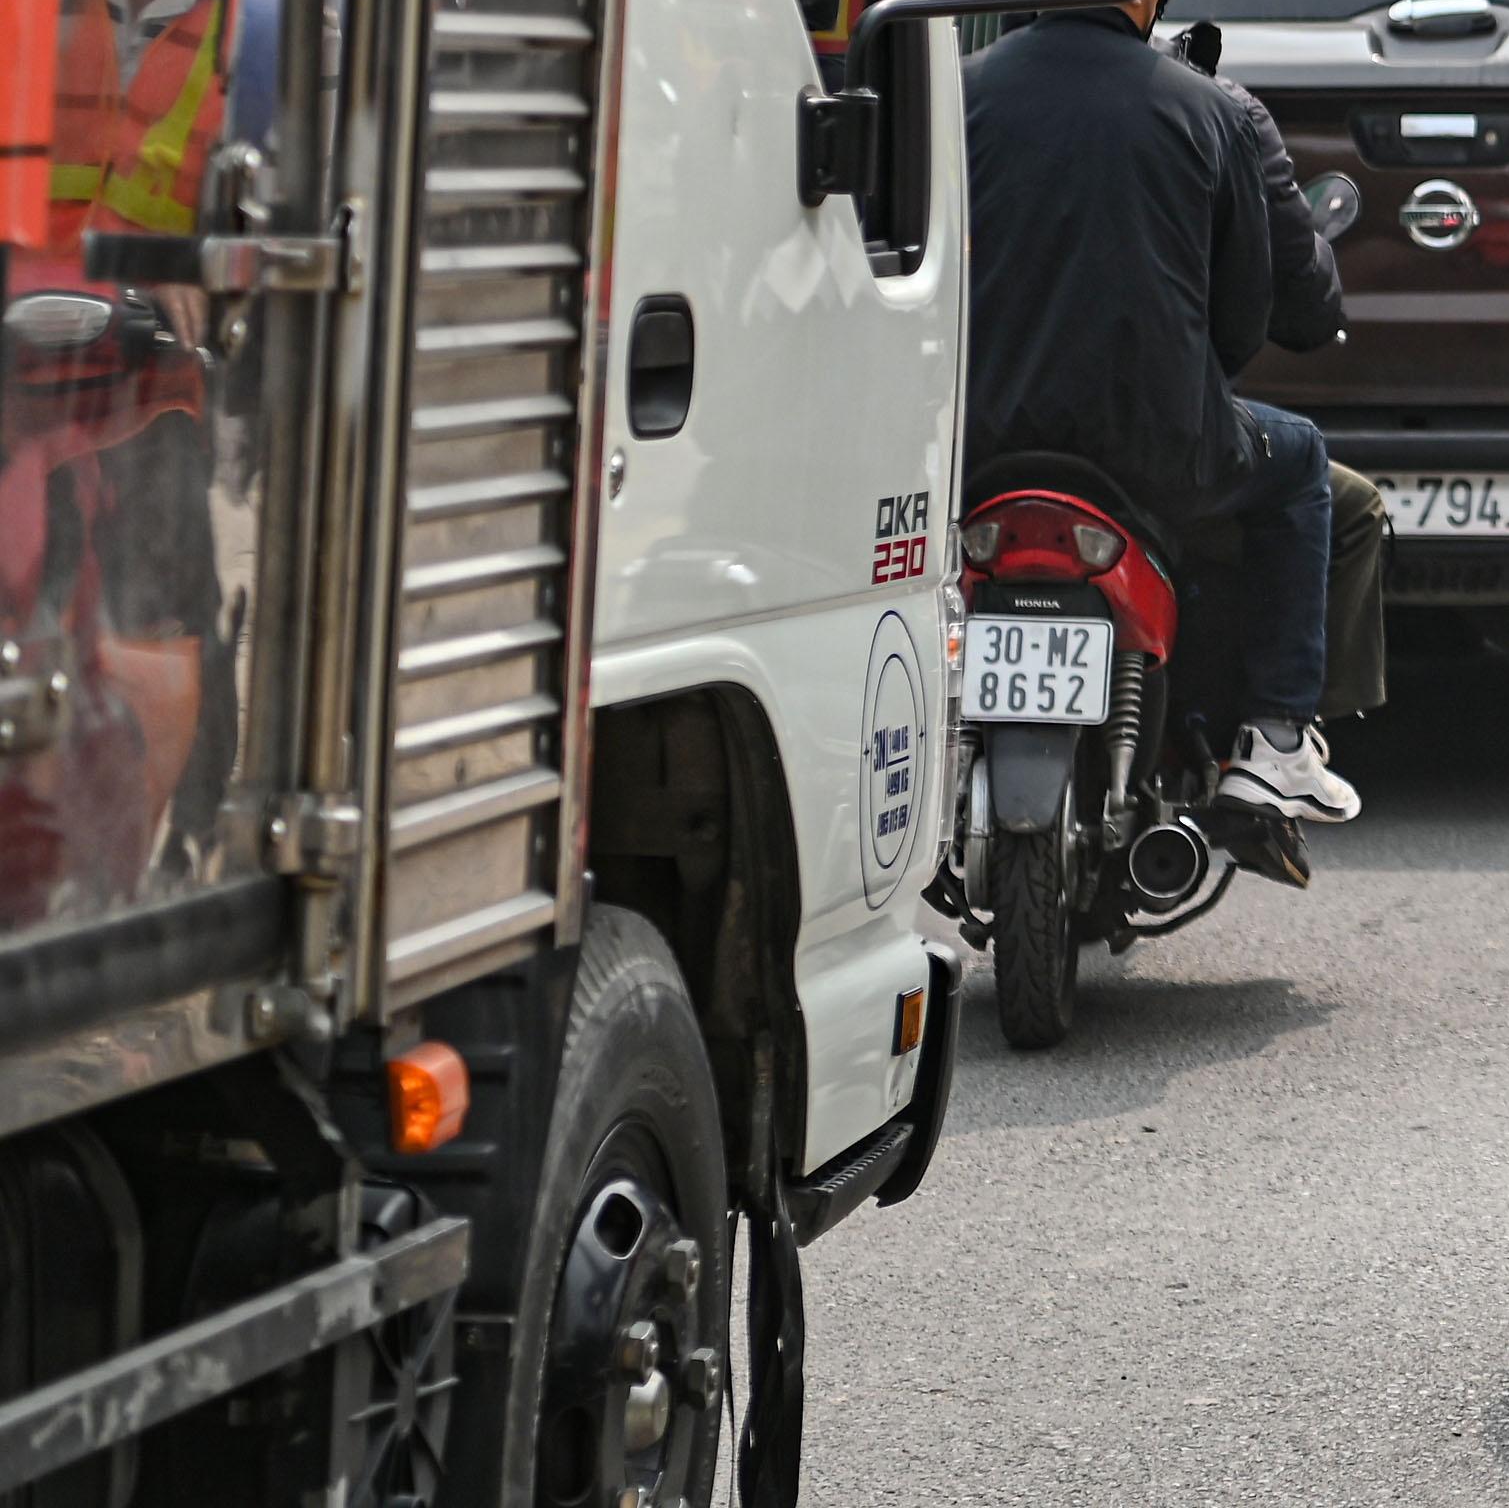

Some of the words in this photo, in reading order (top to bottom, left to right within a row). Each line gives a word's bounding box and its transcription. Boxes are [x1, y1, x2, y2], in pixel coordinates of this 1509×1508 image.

[874, 491, 929, 538] QKR
[872, 536, 927, 585] 230
[1015, 598, 1060, 610] HONDA
[983, 624, 1090, 668] 30-M2
[979, 672, 1086, 716] 8652
